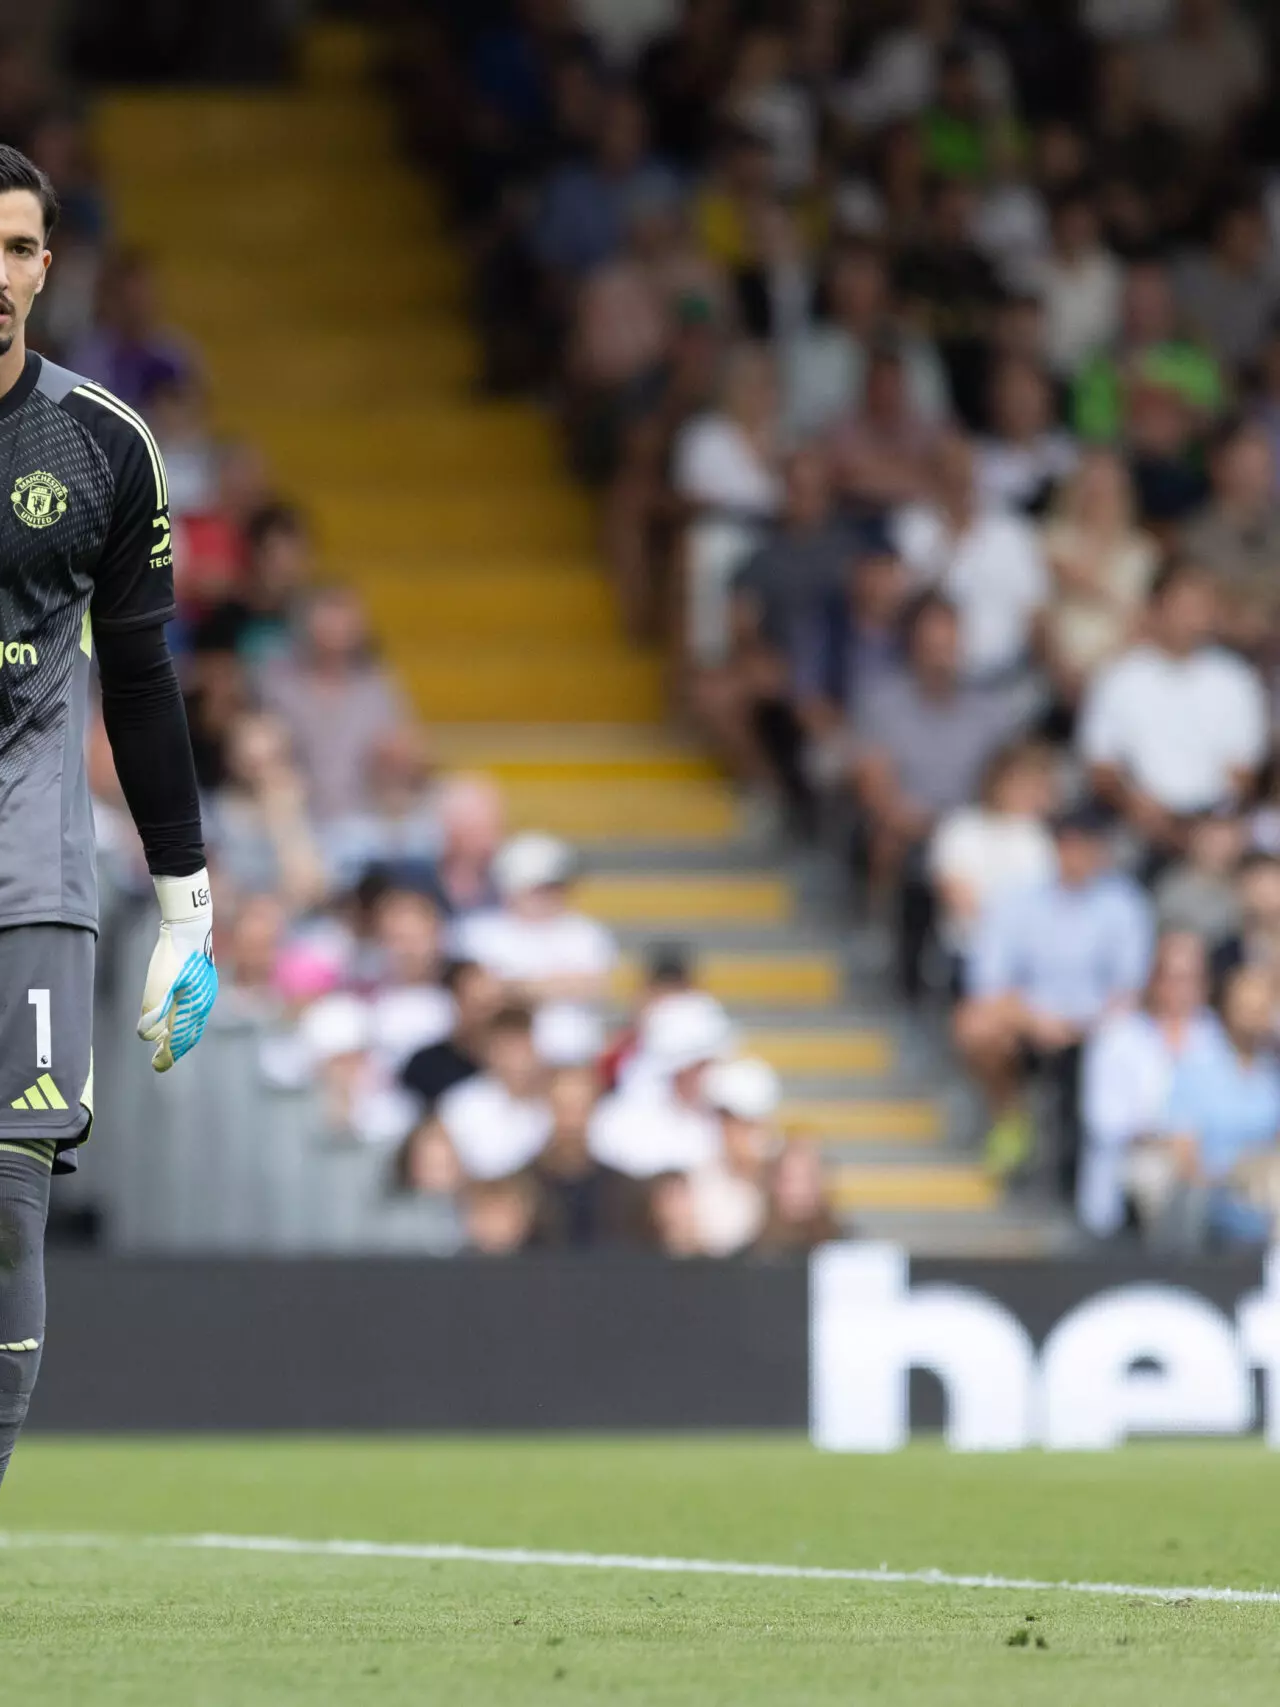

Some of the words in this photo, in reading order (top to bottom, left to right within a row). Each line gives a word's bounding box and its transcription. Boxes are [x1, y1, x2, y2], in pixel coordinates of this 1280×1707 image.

[18, 474, 64, 498] MANCHESTER
[20, 511, 52, 525] UNITED
[28, 988, 52, 1068] 1
